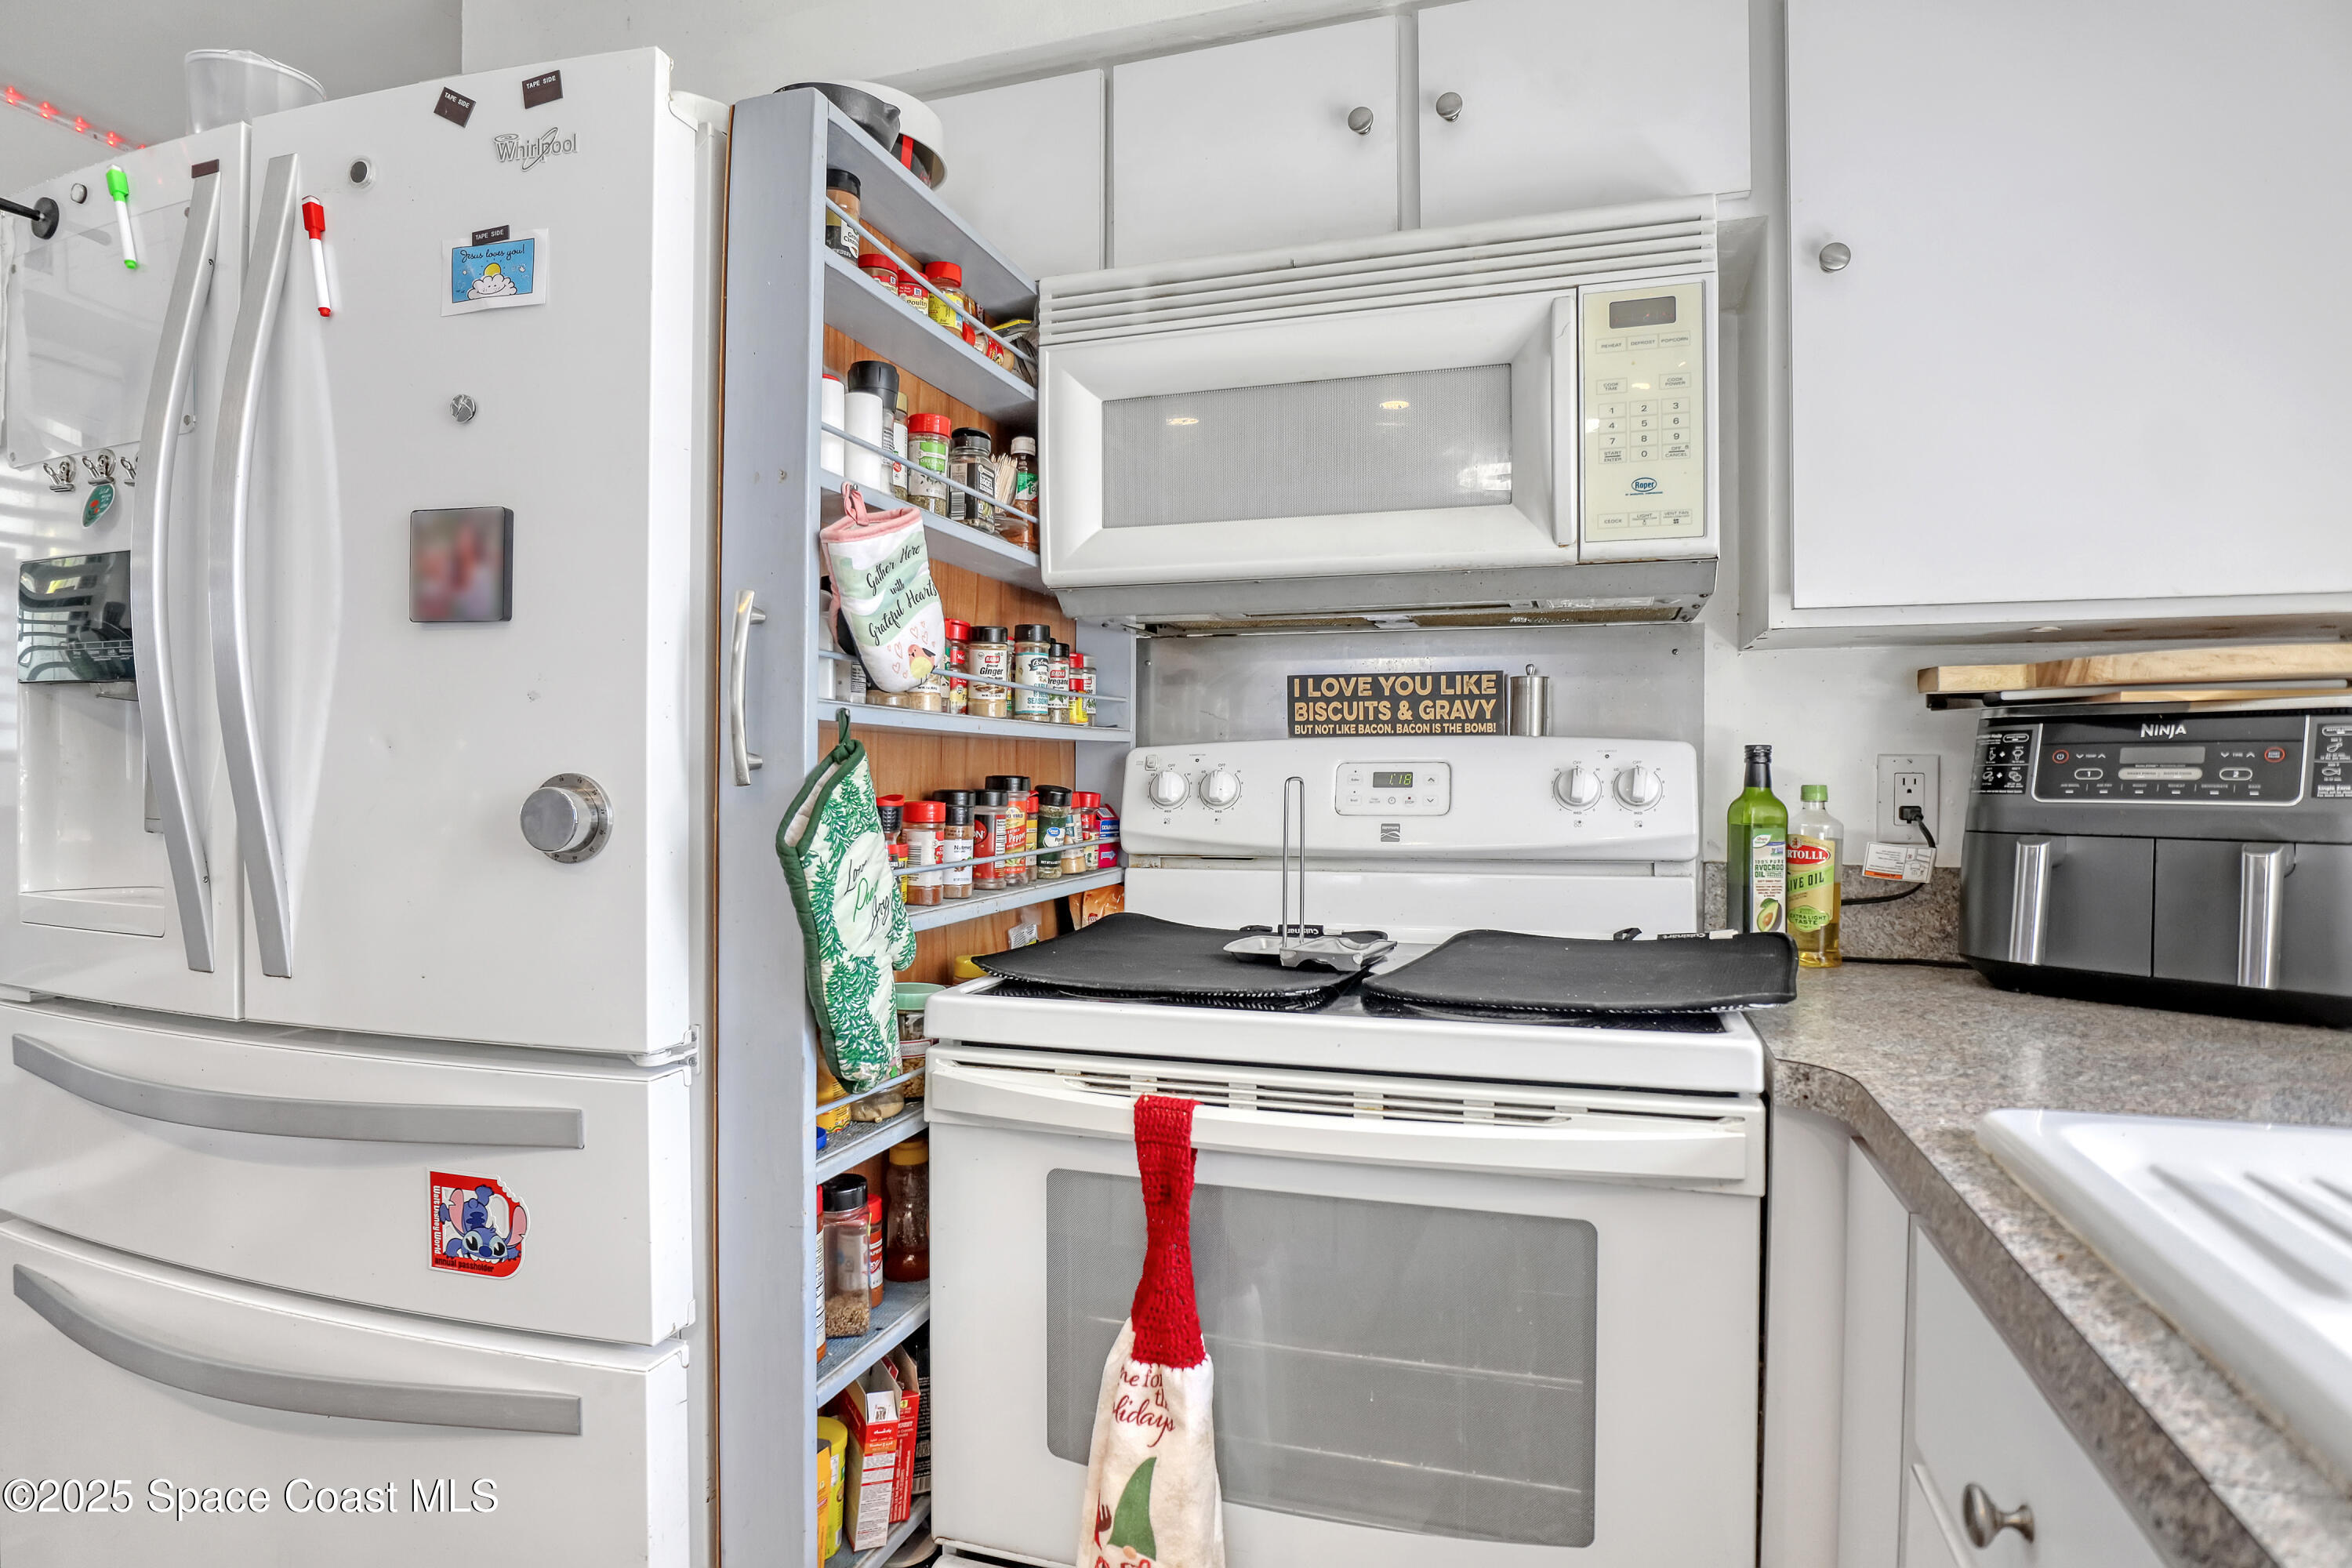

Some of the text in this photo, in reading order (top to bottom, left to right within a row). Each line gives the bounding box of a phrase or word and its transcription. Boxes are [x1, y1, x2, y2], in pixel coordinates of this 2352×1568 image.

[527, 74, 556, 89] TAPE SIDE
[445, 92, 470, 108] TAPE SIDE
[495, 129, 578, 166] Whirlpool
[475, 232, 488, 241] TAPE
[460, 243, 525, 263] Jesus loves you!
[1635, 481, 1655, 490] Roper
[866, 545, 920, 597] Gather Here
[890, 578, 905, 595] with
[869, 579, 938, 646] Grateful Hearts
[980, 667, 1004, 677] Ginger
[1294, 674, 1497, 698] I LOVE YOU LIKE
[1294, 699, 1497, 722] BISCUITS & GRAVY
[1294, 722, 1497, 735] BUT NOT LIKE BACON. BACON IS THE BOMB!
[2140, 723, 2187, 739] NINJA
[1808, 871, 1824, 887] OIL
[433, 1185, 441, 1207] Walt
[434, 1232, 442, 1254] World
[434, 1257, 495, 1272] annual passholder
